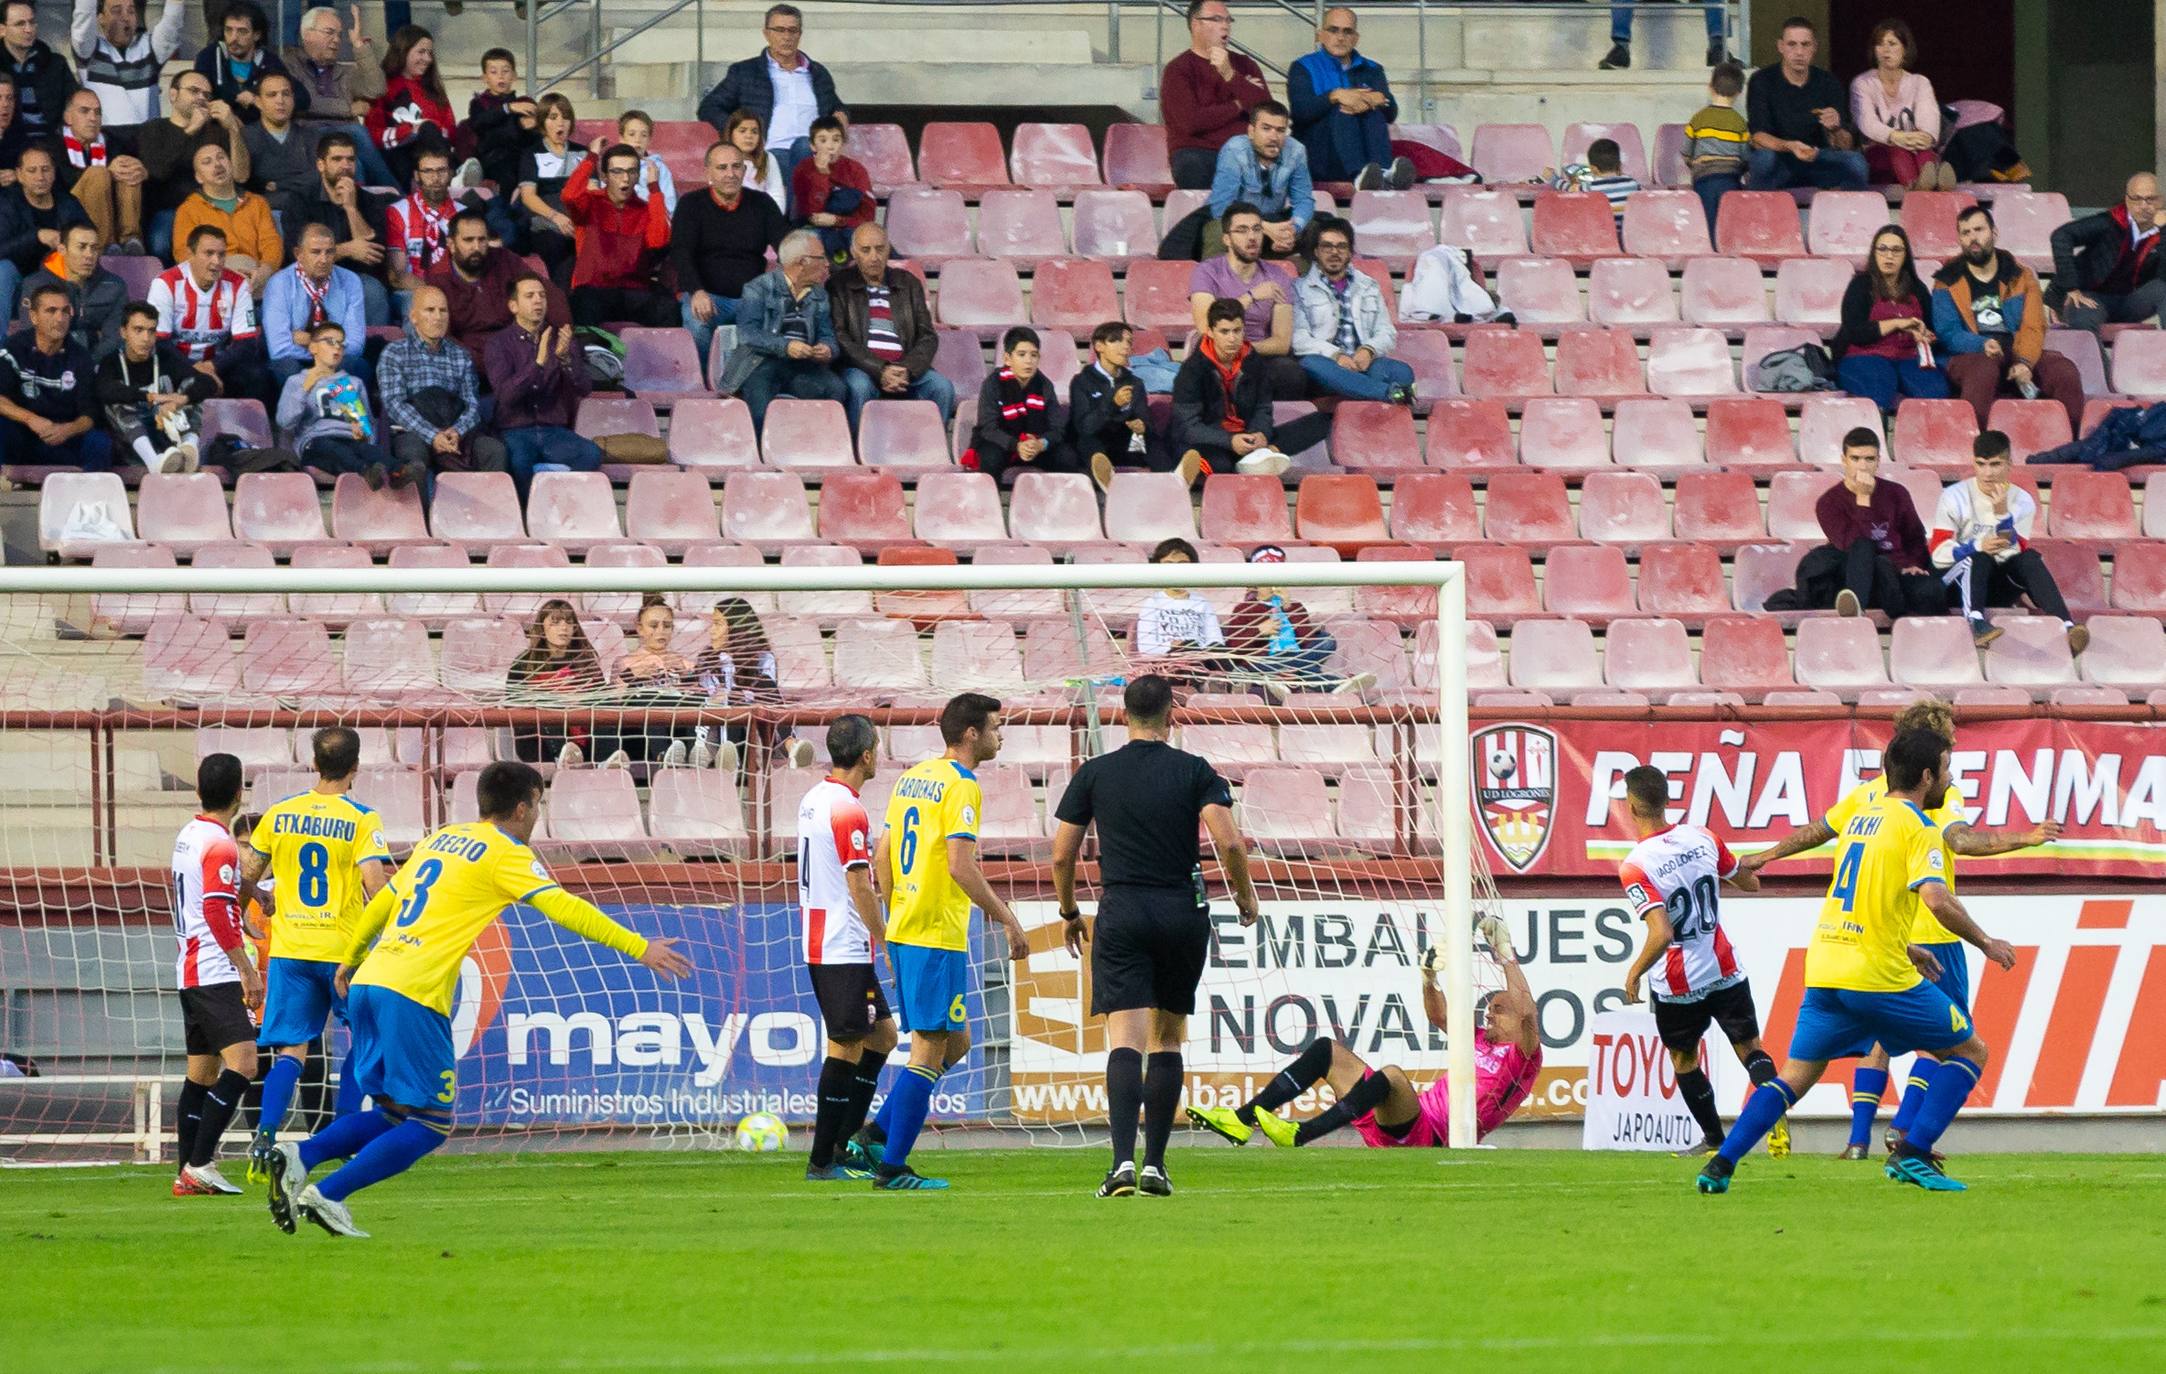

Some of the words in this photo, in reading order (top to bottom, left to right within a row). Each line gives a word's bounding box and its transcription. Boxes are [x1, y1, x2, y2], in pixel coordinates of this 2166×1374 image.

[274, 813, 356, 841] ETXABURU
[899, 806, 920, 875] 6
[429, 833, 487, 862] RECIO
[1675, 845, 1708, 867] LOPEZ
[298, 842, 329, 908] 8
[1833, 842, 1866, 912] 4
[396, 858, 443, 927] 3
[1666, 874, 1728, 944] 20
[949, 993, 966, 1023] 6
[1949, 1004, 1969, 1033] 4
[437, 1070, 456, 1103] 3
[510, 1087, 664, 1114] Suministros
[672, 1088, 817, 1114] Industriales
[1613, 1112, 1692, 1146] JAPOAUTO
